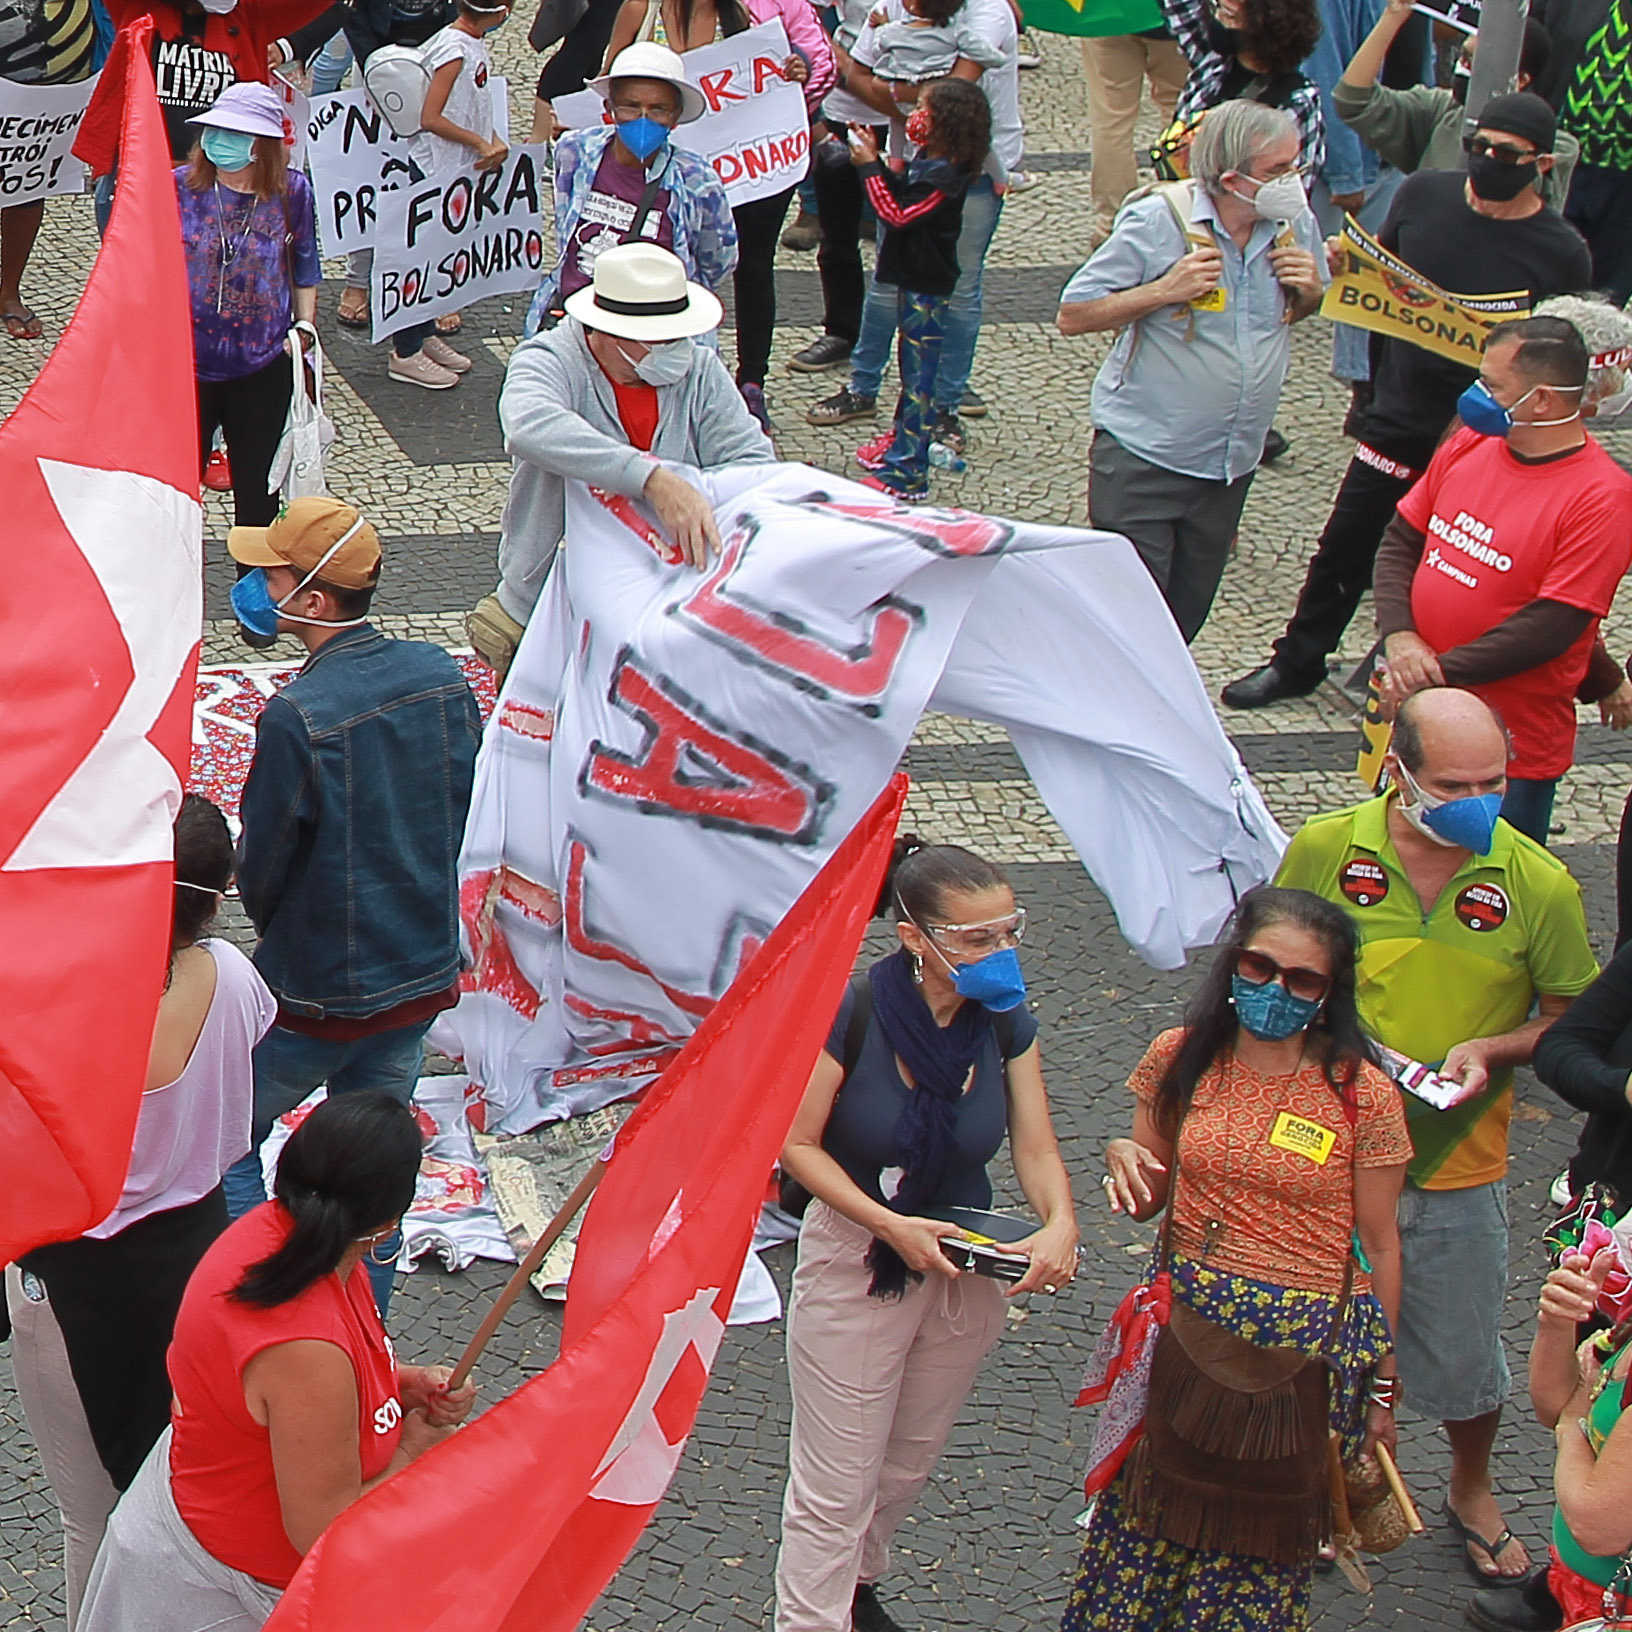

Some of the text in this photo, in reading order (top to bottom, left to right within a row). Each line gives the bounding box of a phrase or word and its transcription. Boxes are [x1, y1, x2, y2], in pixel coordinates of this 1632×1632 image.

[157, 39, 236, 76] MÁTRIA
[307, 100, 346, 142] DIGA
[405, 153, 540, 248] FORA
[378, 227, 545, 321] BOLSONARO
[1429, 514, 1514, 573] BOLSONARO
[1452, 510, 1495, 546] FORA
[1434, 559, 1480, 589] CAMPINAS
[1277, 1110, 1325, 1140] FORA
